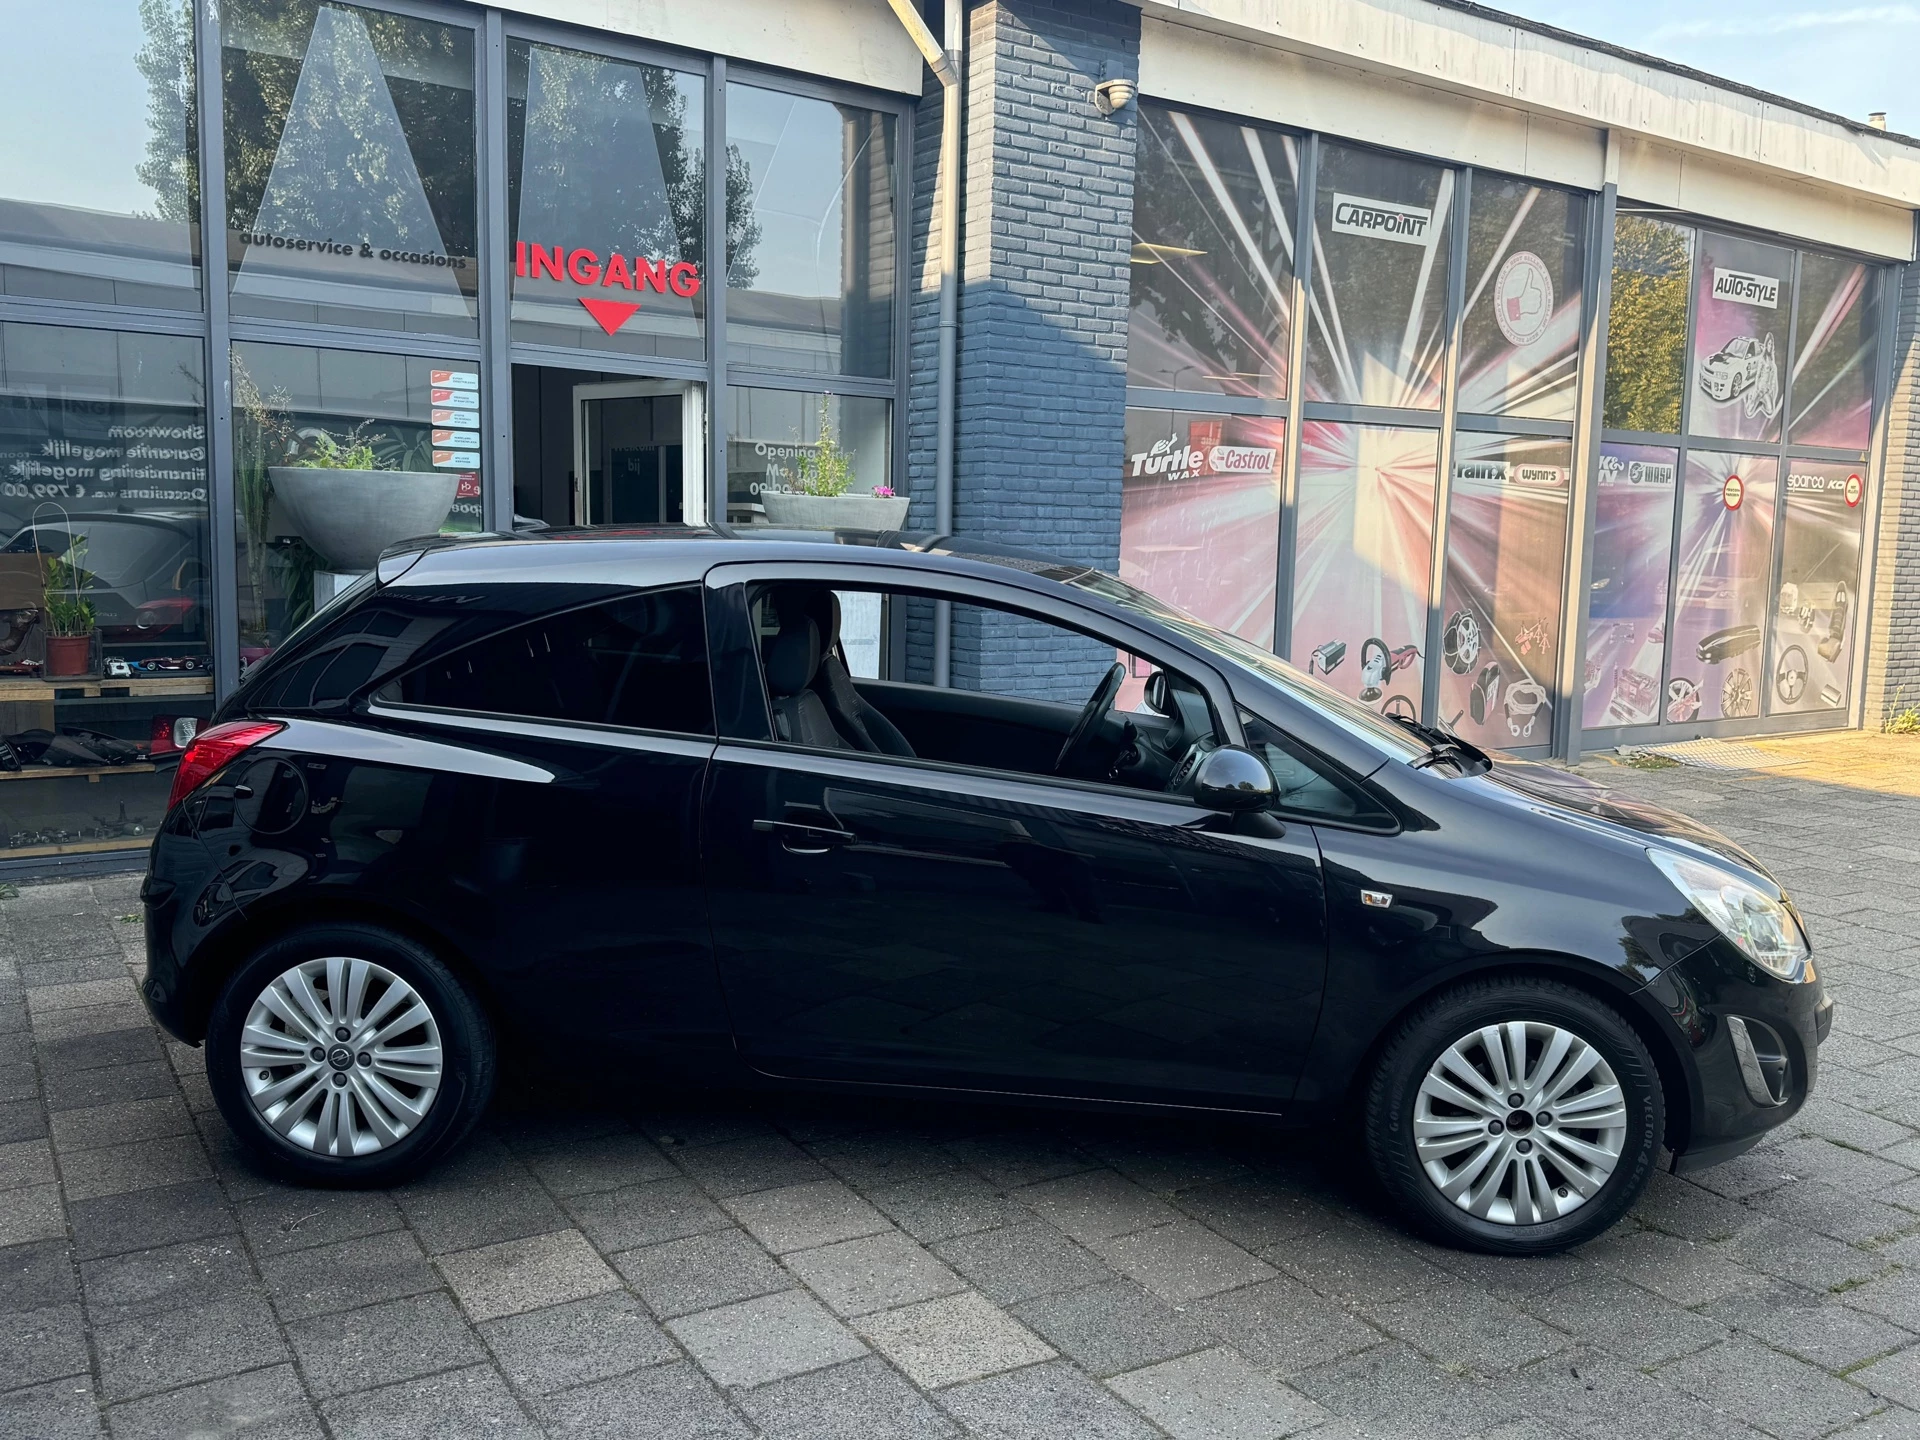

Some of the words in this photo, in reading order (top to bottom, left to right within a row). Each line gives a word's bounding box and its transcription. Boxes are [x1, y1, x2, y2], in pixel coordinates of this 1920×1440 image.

[239, 232, 353, 256] autoservice
[359, 243, 374, 258] &
[379, 247, 467, 269] occasions
[516, 240, 701, 297] INGANG
[627, 458, 641, 475] bij
[1131, 445, 1204, 477] Turtle
[1225, 450, 1272, 470] Castrol
[1167, 468, 1201, 482] WAX
[1645, 466, 1672, 484] WASP
[1787, 473, 1825, 493] sparco
[1643, 1095, 1655, 1149] VECTOR
